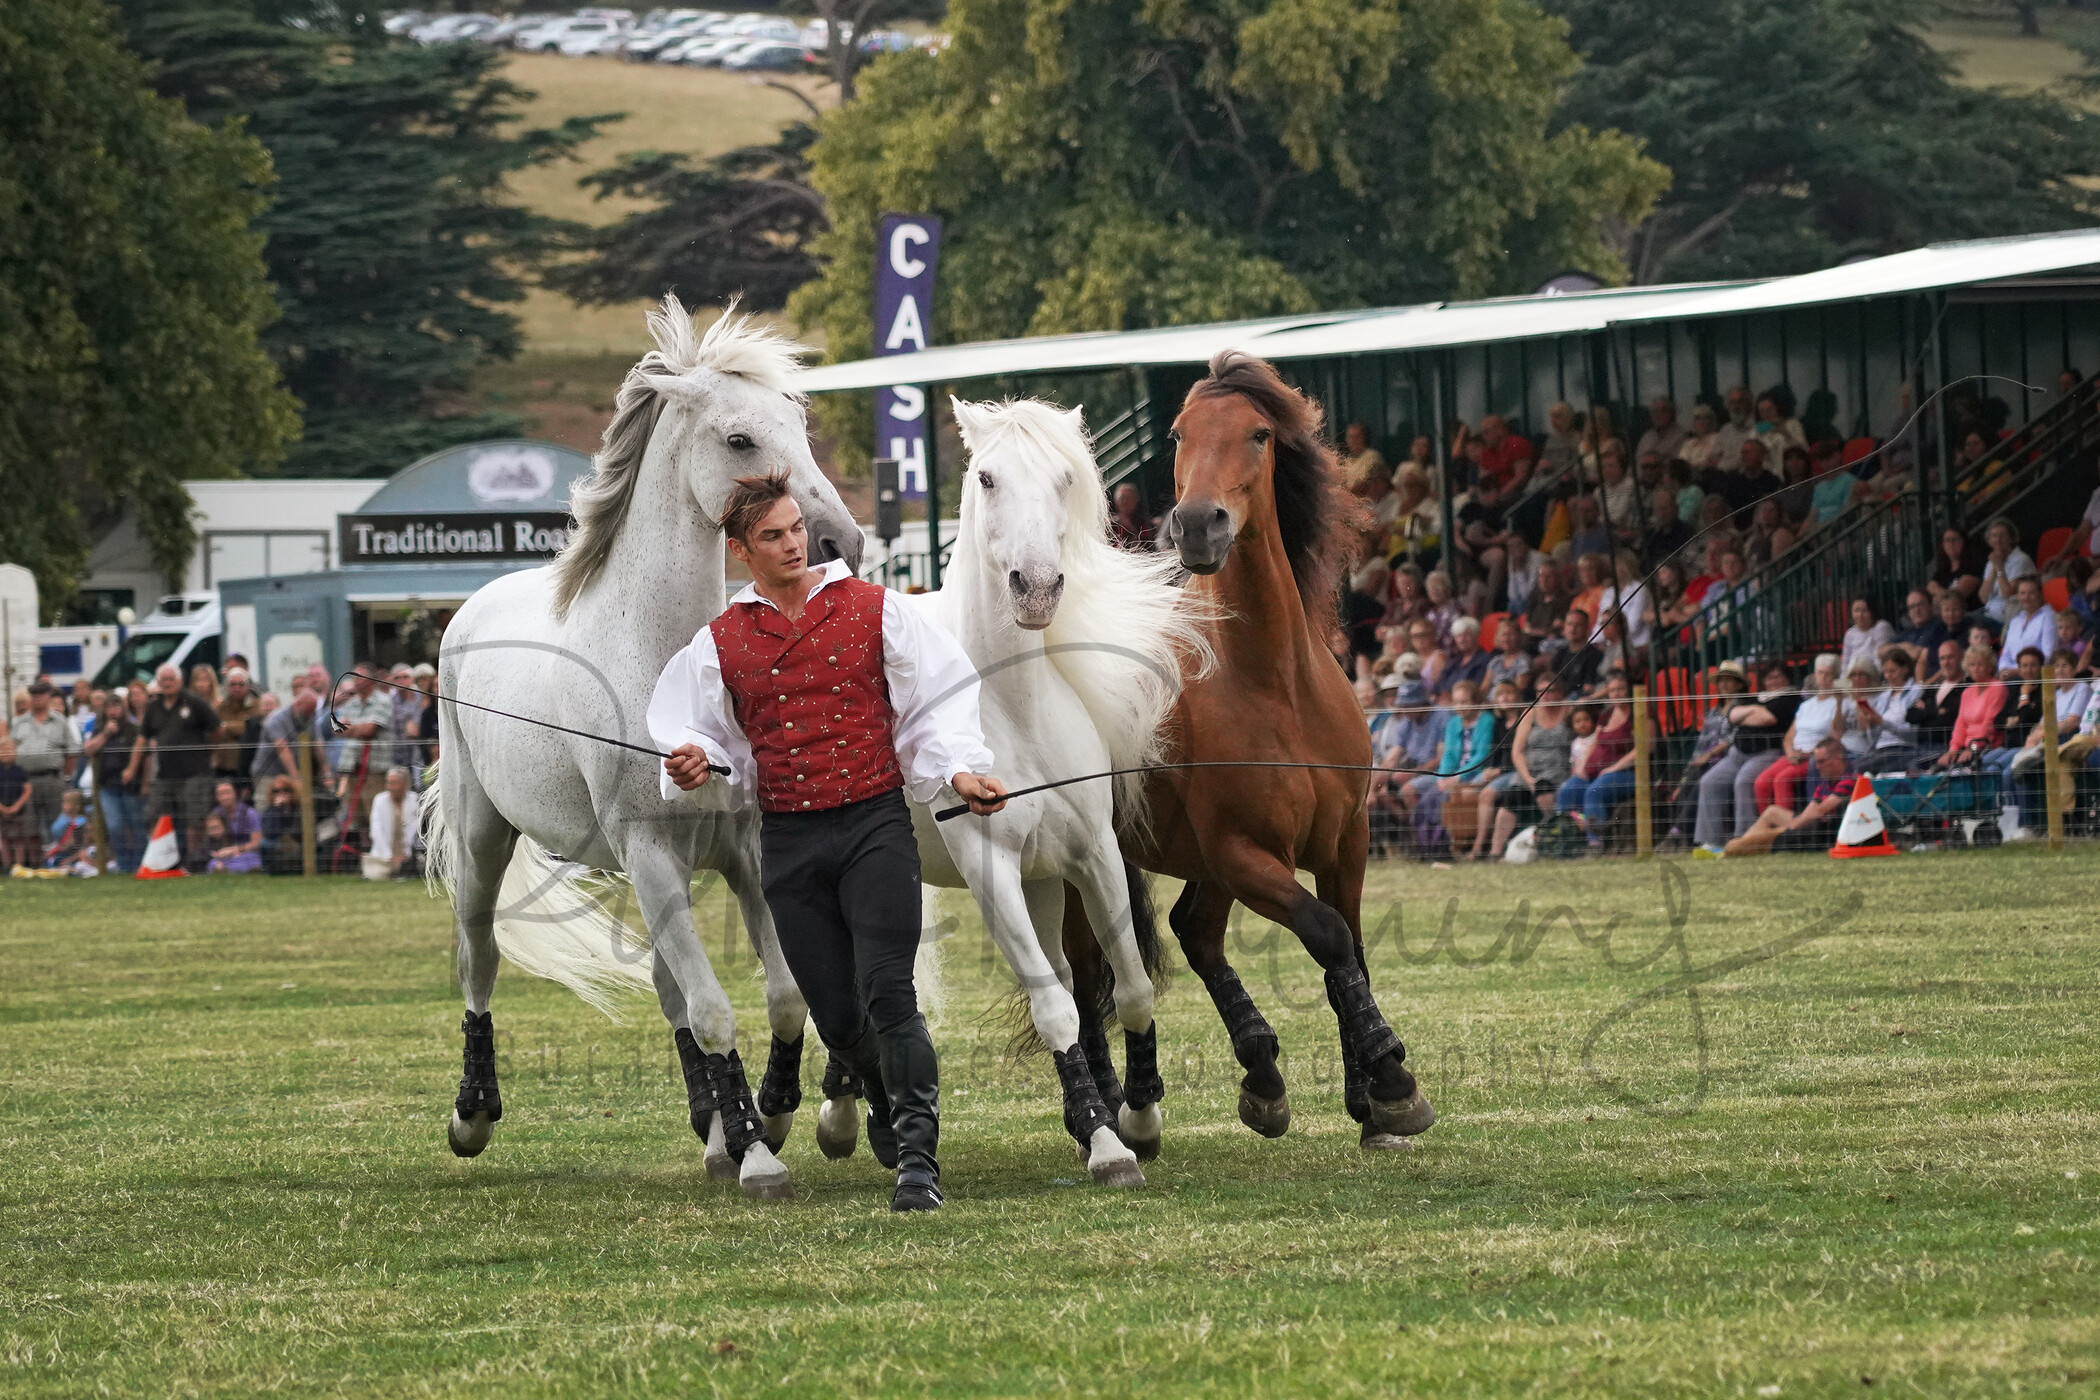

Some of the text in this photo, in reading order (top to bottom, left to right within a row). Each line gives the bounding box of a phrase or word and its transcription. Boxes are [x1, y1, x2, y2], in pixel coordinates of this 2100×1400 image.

[885, 222, 929, 493] CASH
[352, 520, 567, 555] Traditional Roa
